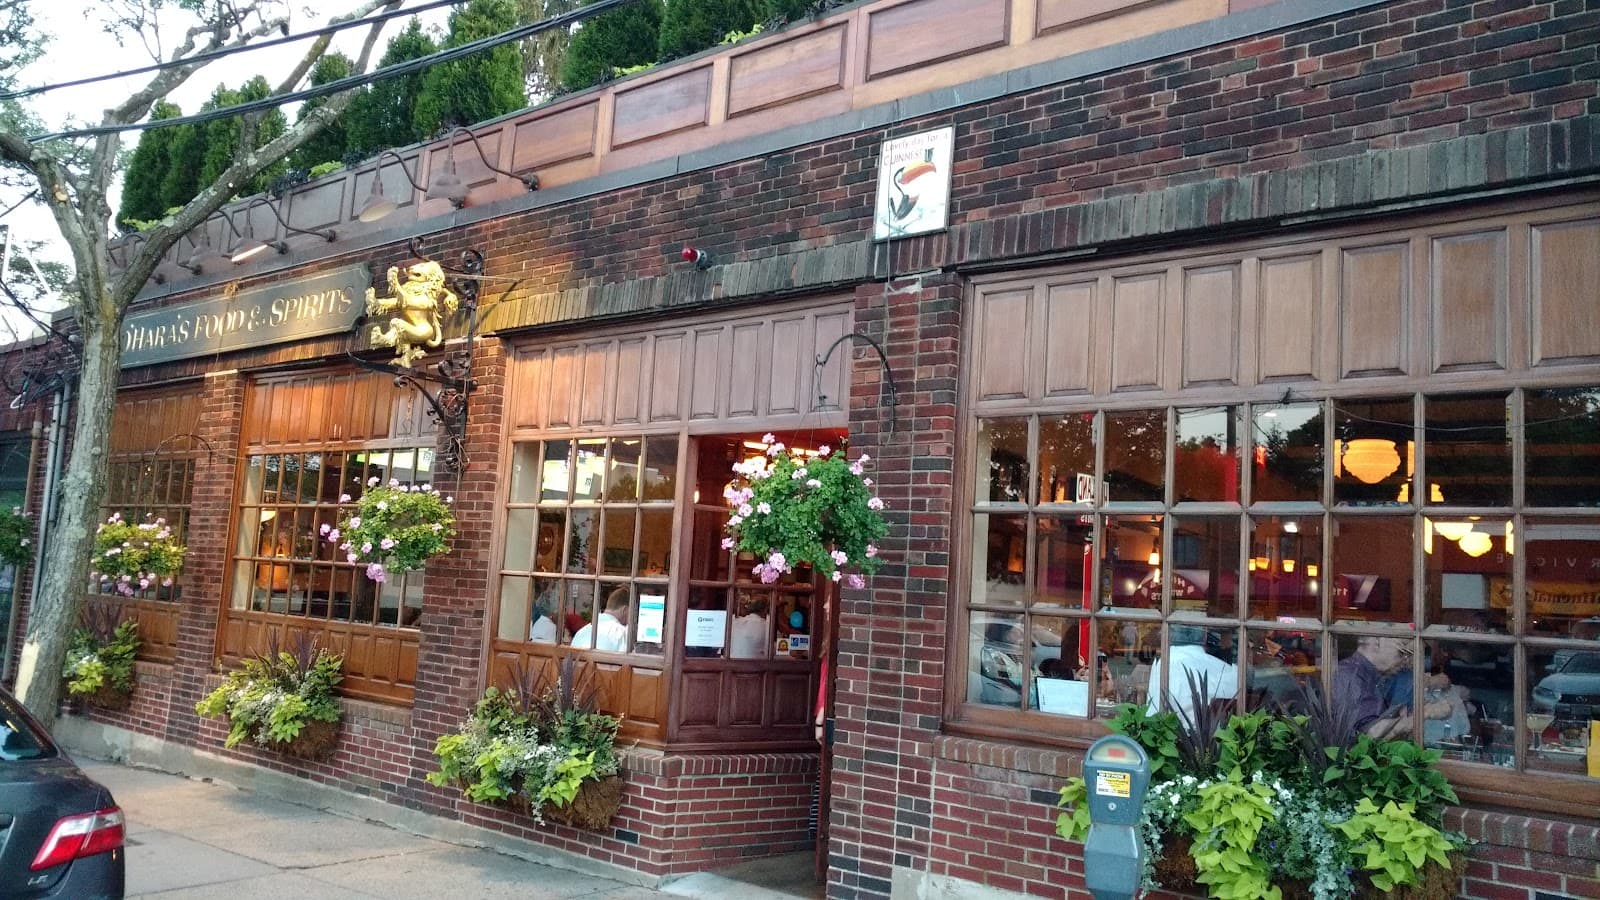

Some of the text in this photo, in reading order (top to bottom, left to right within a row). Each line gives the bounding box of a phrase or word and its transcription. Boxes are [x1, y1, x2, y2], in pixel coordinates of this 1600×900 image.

[885, 141, 909, 152] Lovely
[883, 148, 923, 166] GUINNESS
[194, 308, 246, 342] FOOD
[247, 304, 266, 332] &
[269, 287, 353, 328] SPIRITS
